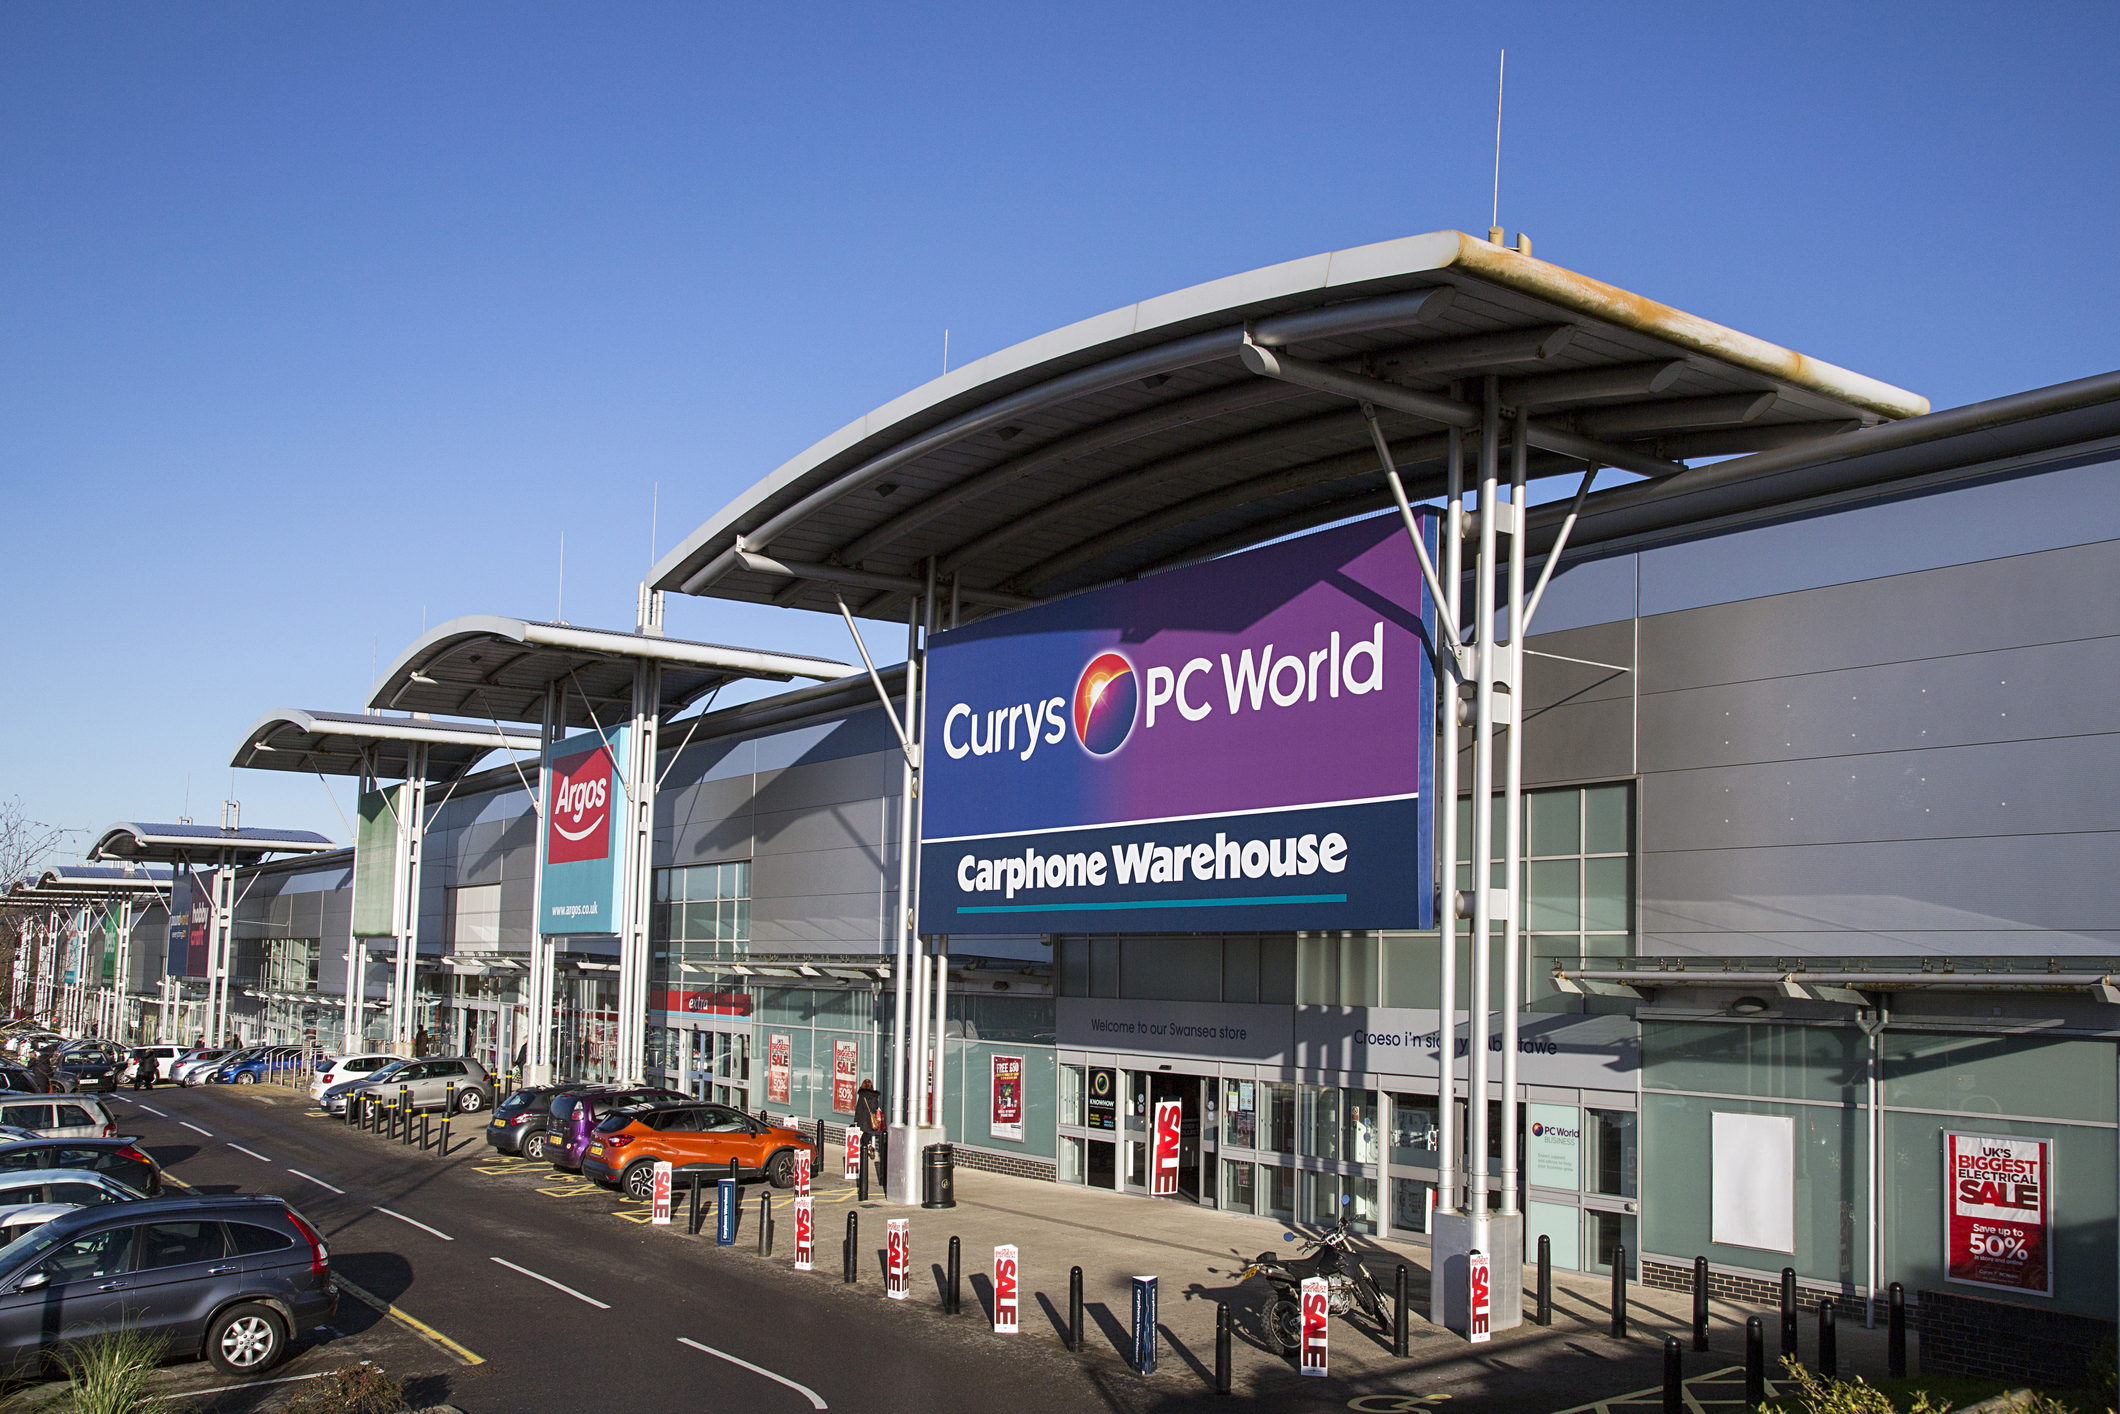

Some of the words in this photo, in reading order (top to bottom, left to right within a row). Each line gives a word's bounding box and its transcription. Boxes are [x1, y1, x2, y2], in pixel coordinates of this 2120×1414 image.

[943, 697, 1066, 761] Currys
[1146, 658, 1213, 728] PC
[1221, 621, 1384, 715] World
[555, 775, 607, 823] Argos
[957, 848, 1108, 899] Carphone
[1112, 832, 1348, 884] Warehouse
[192, 902, 209, 930] hobby
[552, 901, 598, 918] www.argos.co.uk
[191, 924, 203, 946] craft
[688, 996, 708, 1010] extra
[1091, 1018, 1134, 1033] Welcome
[1138, 1021, 1147, 1034] to
[1150, 1024, 1167, 1034] our
[1169, 1022, 1216, 1038] Swansea
[1220, 1026, 1247, 1040] store
[1354, 1030, 1400, 1046] Croeso
[1405, 1032, 1422, 1048] i'n
[772, 1054, 788, 1067] SALE
[837, 1049, 856, 1058] BIGGEST
[837, 1062, 855, 1075] SALE
[997, 1063, 1008, 1073] FREE
[839, 1088, 853, 1100] 50%
[1090, 1099, 1114, 1107] KNOWHOW
[1544, 1126, 1555, 1136] PC
[1556, 1128, 1579, 1138] World
[1544, 1136, 1575, 1146] BUSINESS
[847, 1134, 860, 1175] SALE
[1155, 1105, 1180, 1193] SALE
[1982, 1147, 2011, 1158] UK'S
[1958, 1155, 2038, 1174] BIGGEST
[800, 1158, 810, 1197] SALE
[1958, 1169, 2038, 1184] ELECTRICAL
[654, 1170, 670, 1218] SALE
[1958, 1179, 2038, 1211] SALE
[796, 1207, 810, 1263] SALE
[1973, 1224, 1995, 1234] Save
[1998, 1228, 2010, 1237] up
[2013, 1228, 2024, 1237] to
[1969, 1233, 2028, 1260] 50%
[888, 1230, 900, 1292] SALE
[996, 1258, 1016, 1325] SALE
[1472, 1266, 1488, 1334] SALE
[1303, 1292, 1327, 1367] SALE
